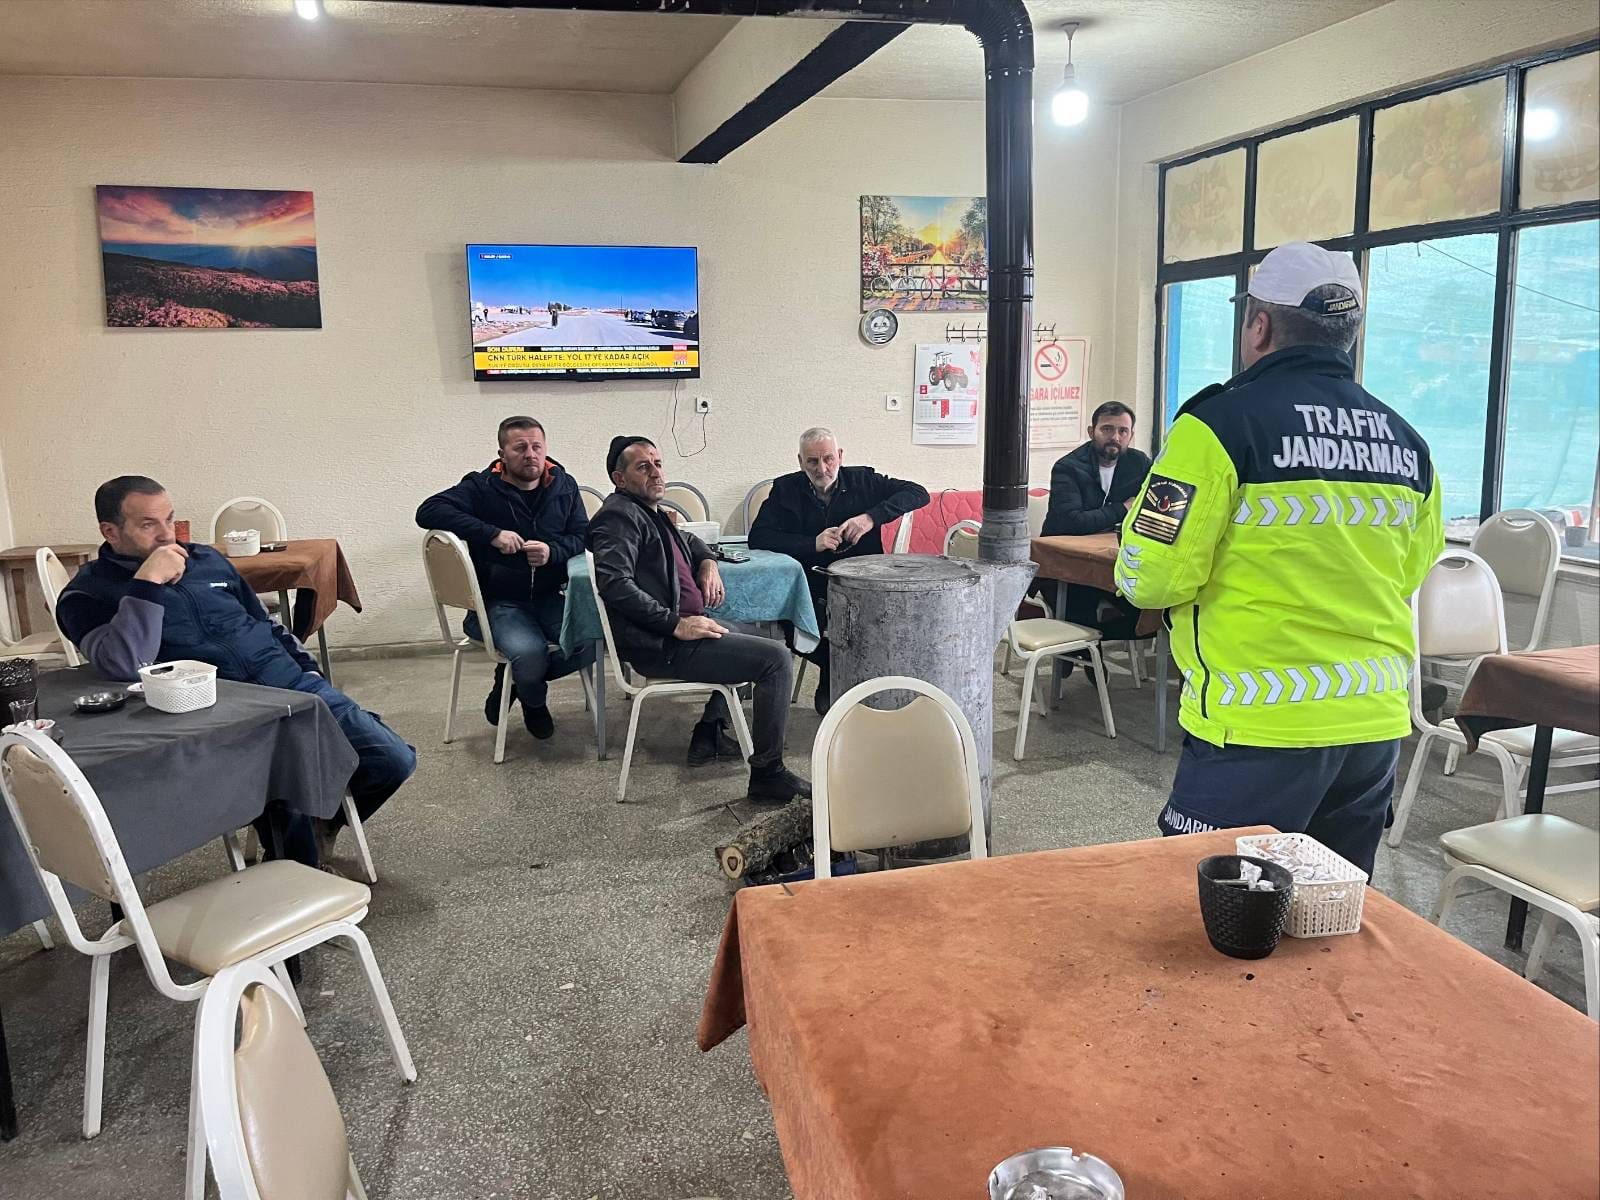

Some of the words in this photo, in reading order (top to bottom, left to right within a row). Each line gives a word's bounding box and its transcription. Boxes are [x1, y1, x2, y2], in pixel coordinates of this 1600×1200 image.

[507, 353, 527, 361] TÜRK
[567, 353, 582, 361] YOL
[632, 353, 650, 361] AÇIK
[1273, 436, 1419, 480] JANDARMASI
[1165, 805, 1220, 834] JANDARM
